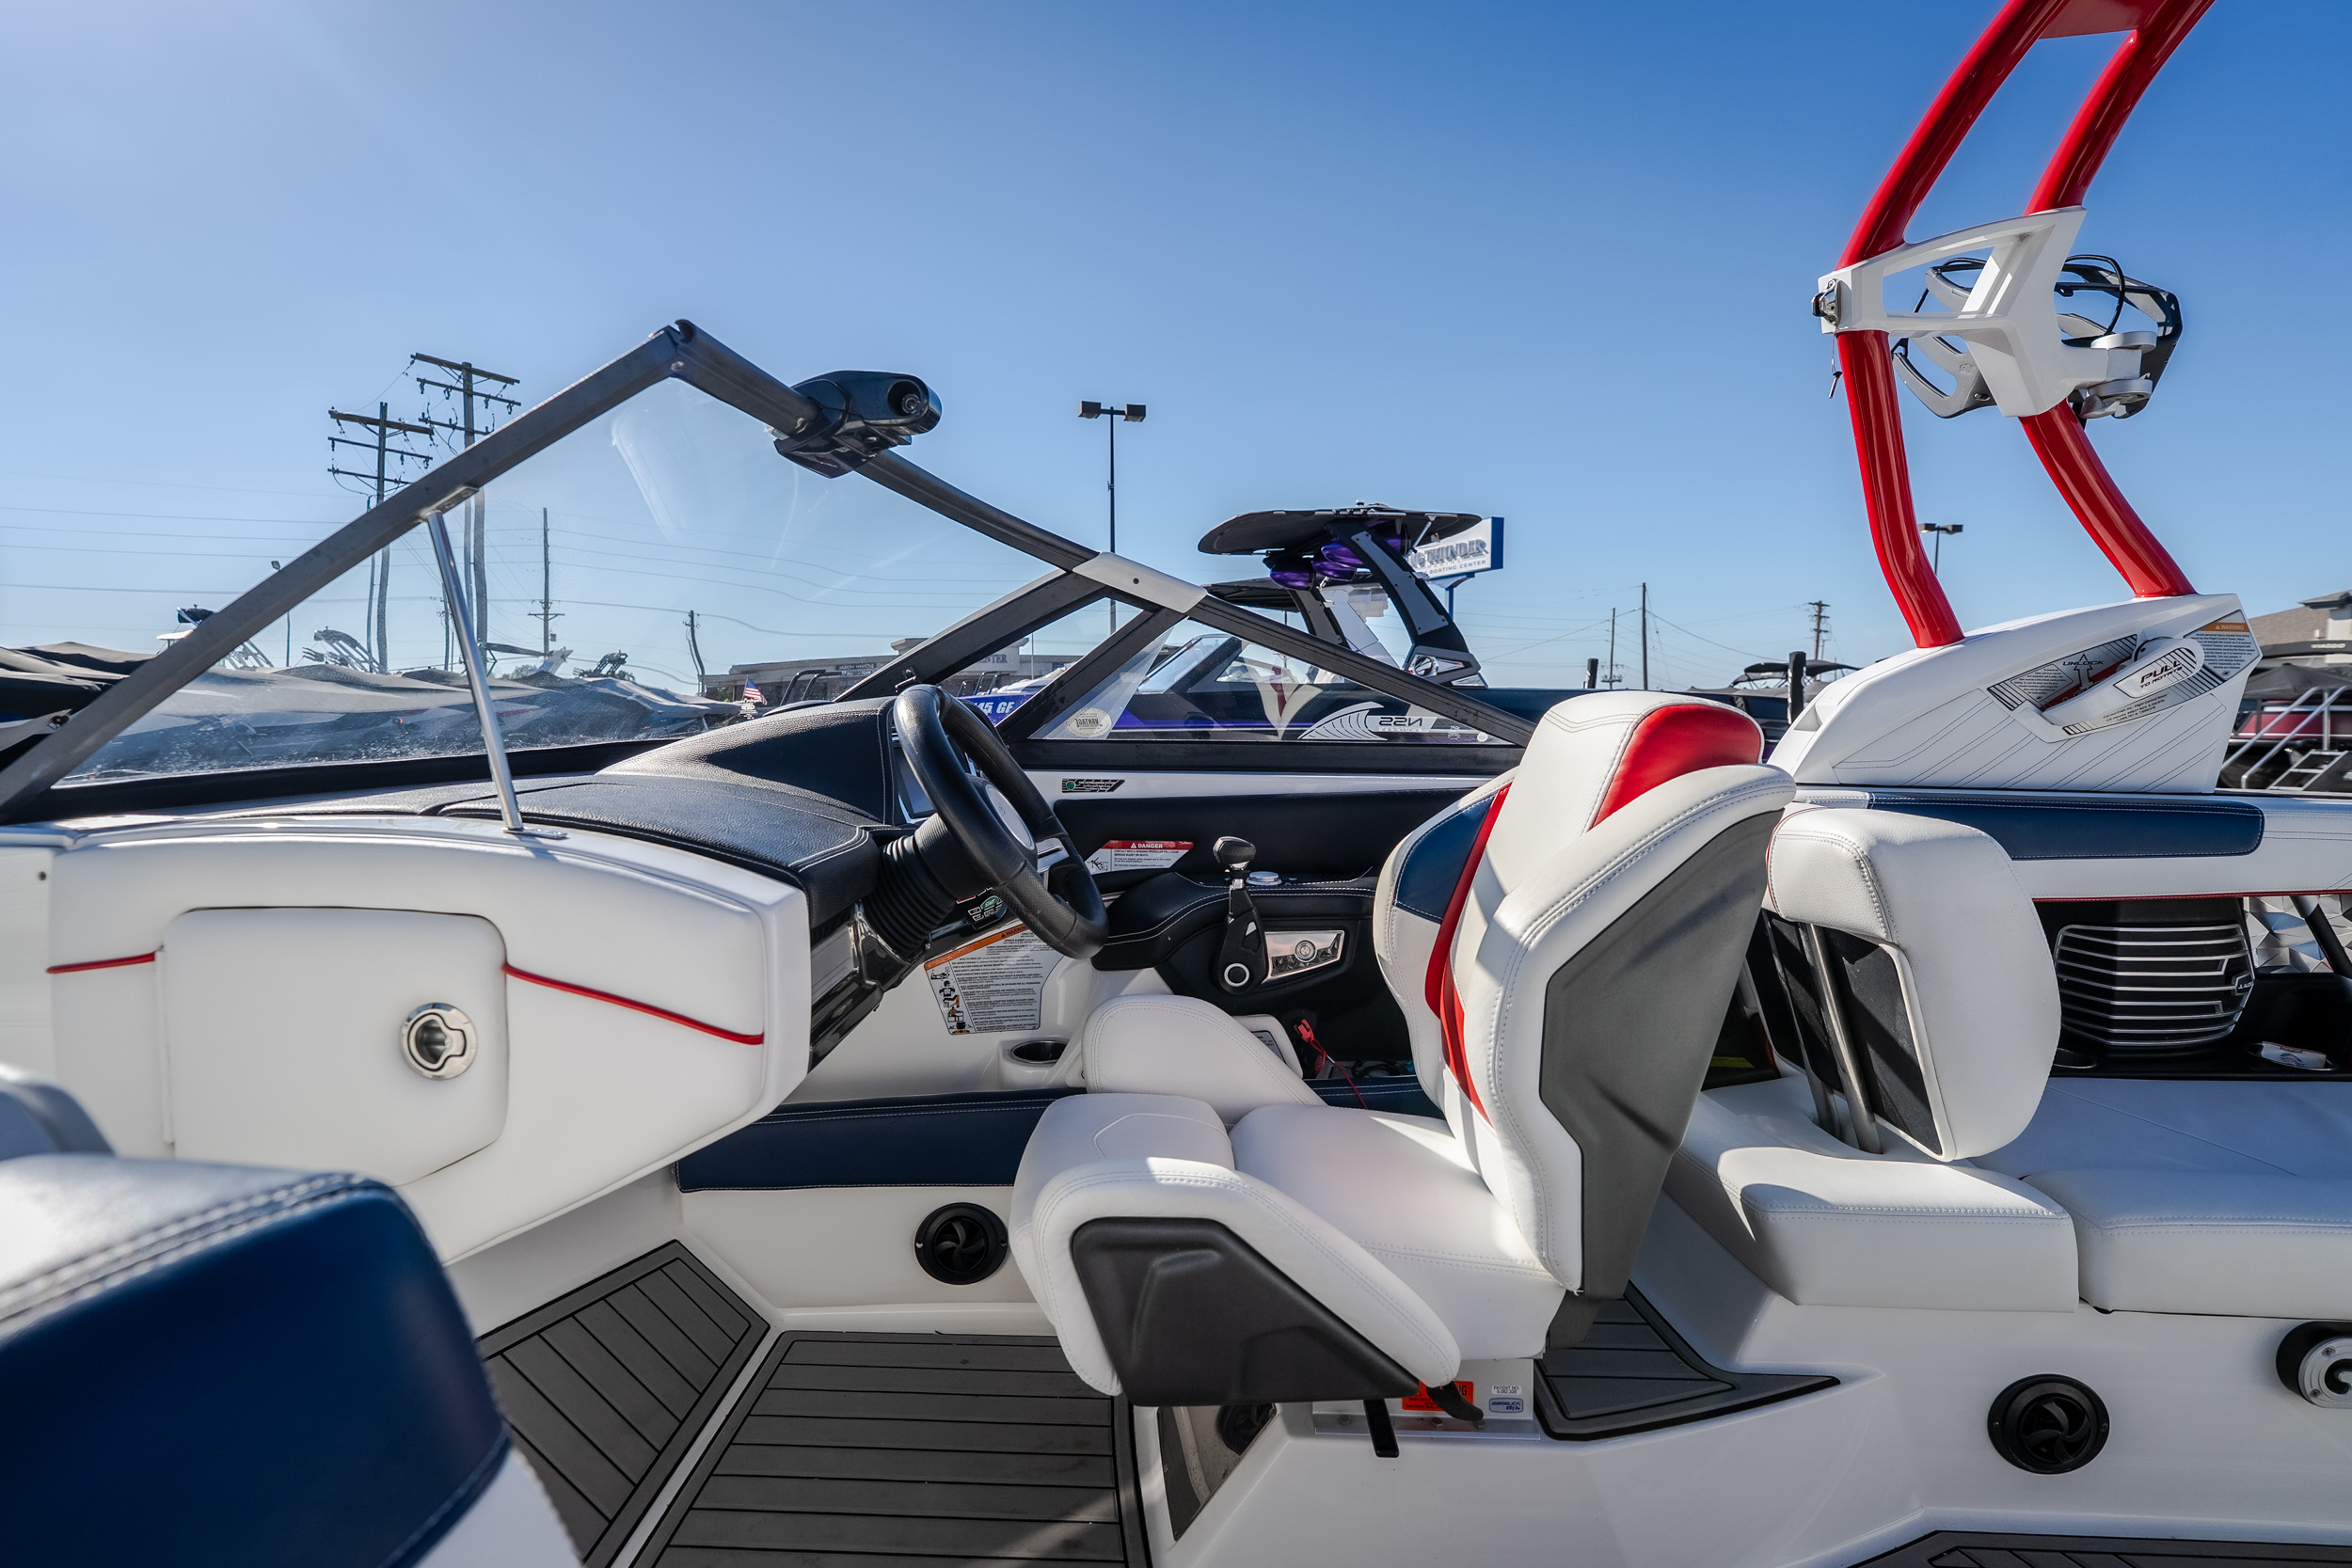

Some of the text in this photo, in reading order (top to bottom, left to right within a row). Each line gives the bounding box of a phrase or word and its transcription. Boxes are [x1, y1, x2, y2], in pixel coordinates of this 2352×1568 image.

[1424, 539, 1488, 562] THUNDER
[1429, 559, 1486, 575] BOATING CENTER
[2140, 660, 2182, 684] PULL
[2152, 666, 2183, 684] ROTATE
[1005, 926, 1030, 936] WARNIN
